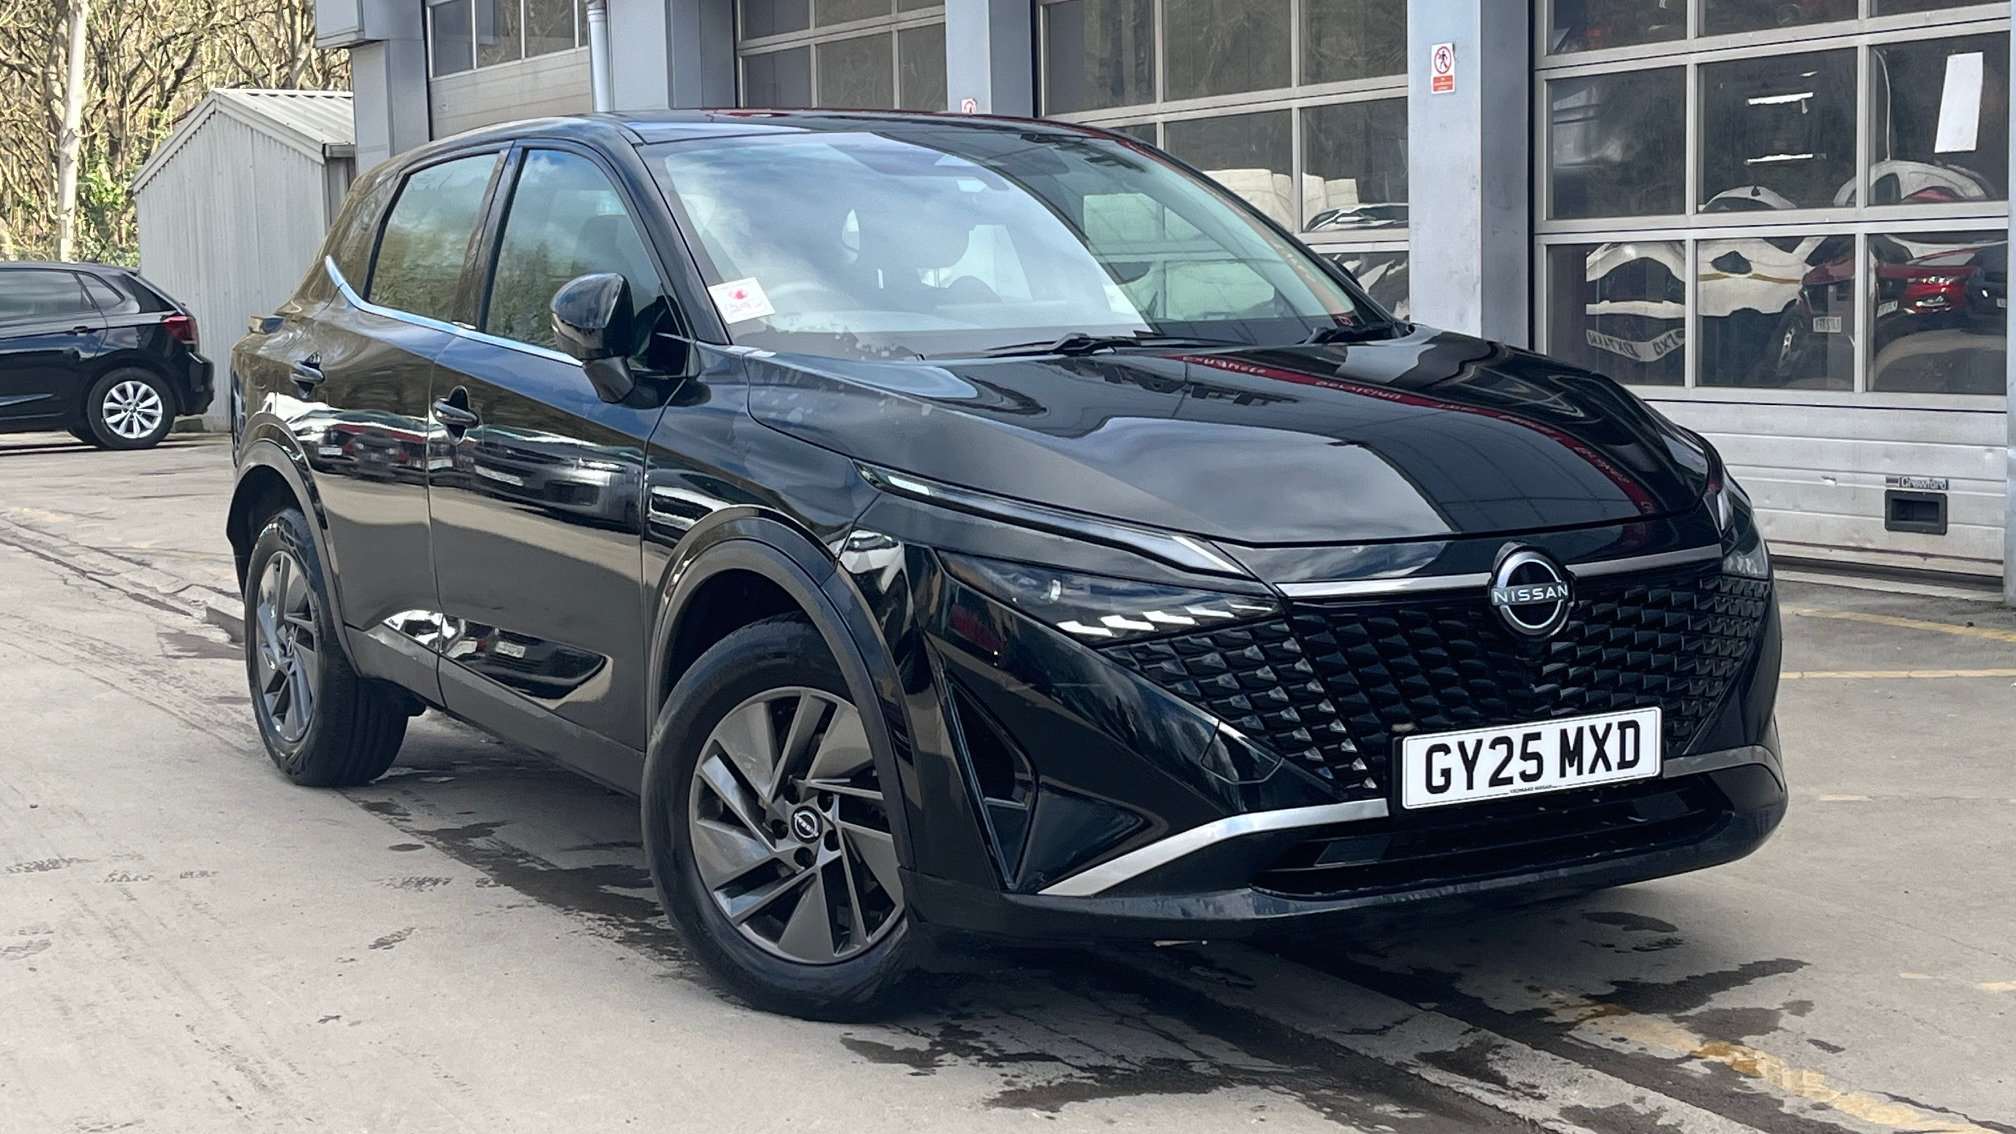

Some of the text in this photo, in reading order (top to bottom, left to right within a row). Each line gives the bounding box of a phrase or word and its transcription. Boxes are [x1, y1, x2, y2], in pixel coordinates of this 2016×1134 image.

[1902, 476, 1947, 490] Crawford
[1493, 584, 1568, 602] NISSAN
[1425, 719, 1641, 795] GY25 MXD
